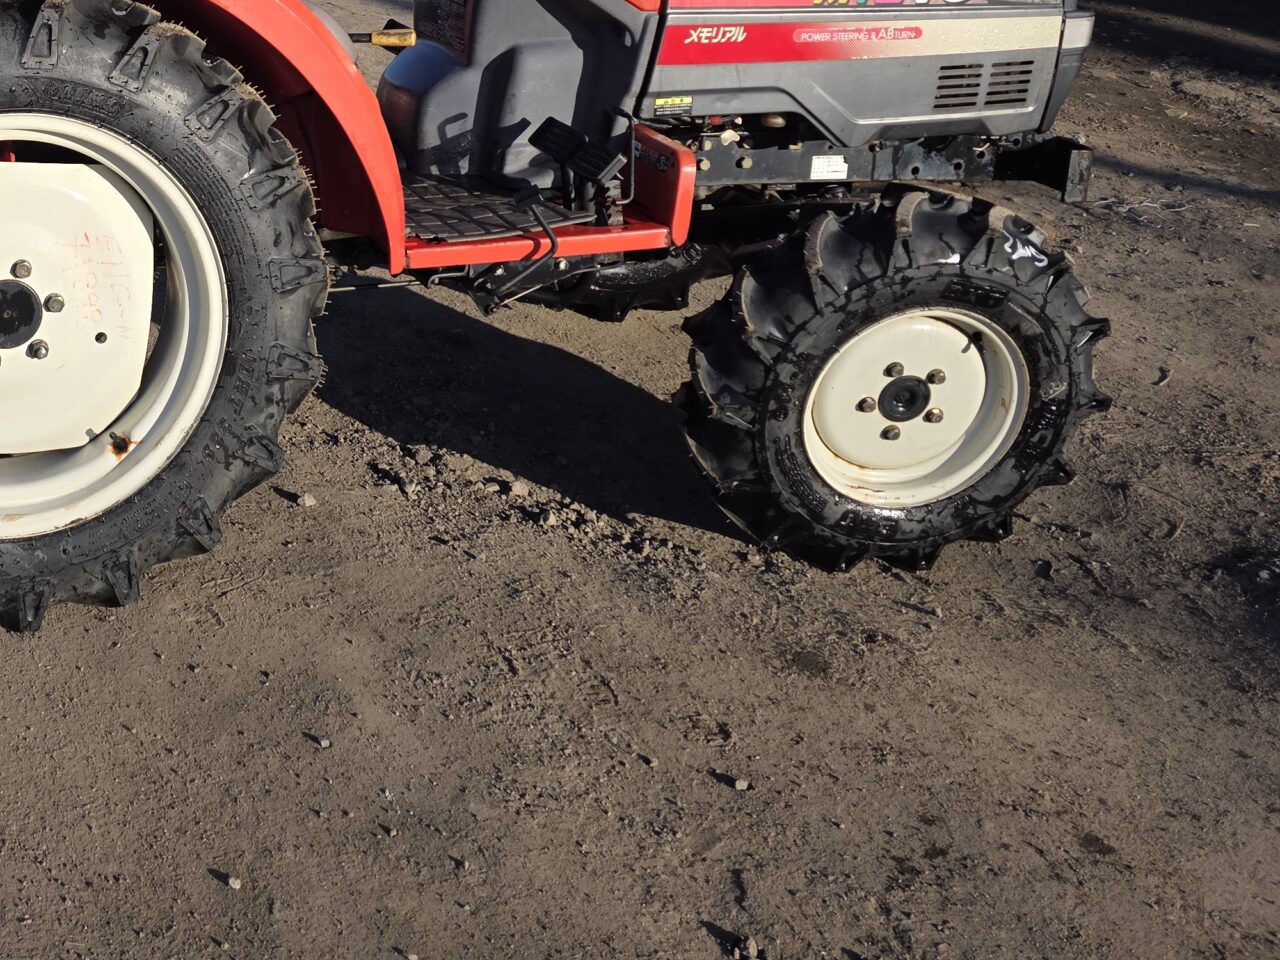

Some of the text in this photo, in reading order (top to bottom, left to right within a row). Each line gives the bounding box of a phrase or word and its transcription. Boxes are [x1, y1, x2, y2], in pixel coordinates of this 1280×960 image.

[684, 25, 748, 45] メモリアル
[801, 32, 832, 41] POWER
[832, 30, 869, 41] STEERING
[870, 30, 878, 41] &
